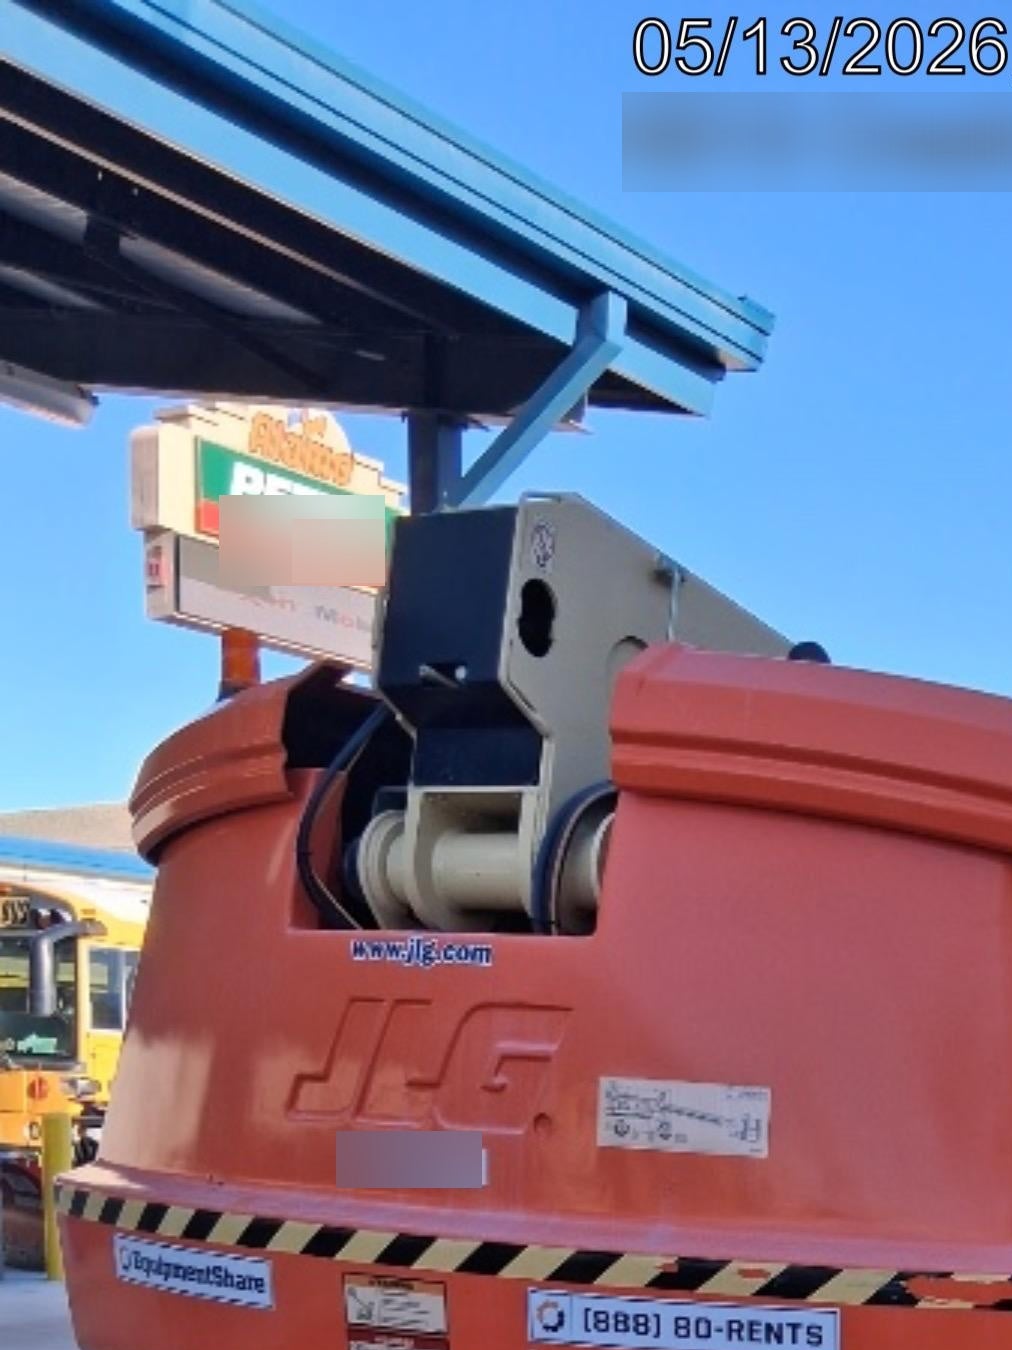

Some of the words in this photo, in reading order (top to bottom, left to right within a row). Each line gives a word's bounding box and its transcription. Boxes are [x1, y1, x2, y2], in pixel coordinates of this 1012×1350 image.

[353, 938, 491, 967] www.jlg.com
[286, 996, 573, 1135] JLG
[133, 1250, 267, 1294] EquipmentShare
[673, 1316, 823, 1347] 80-RENTS
